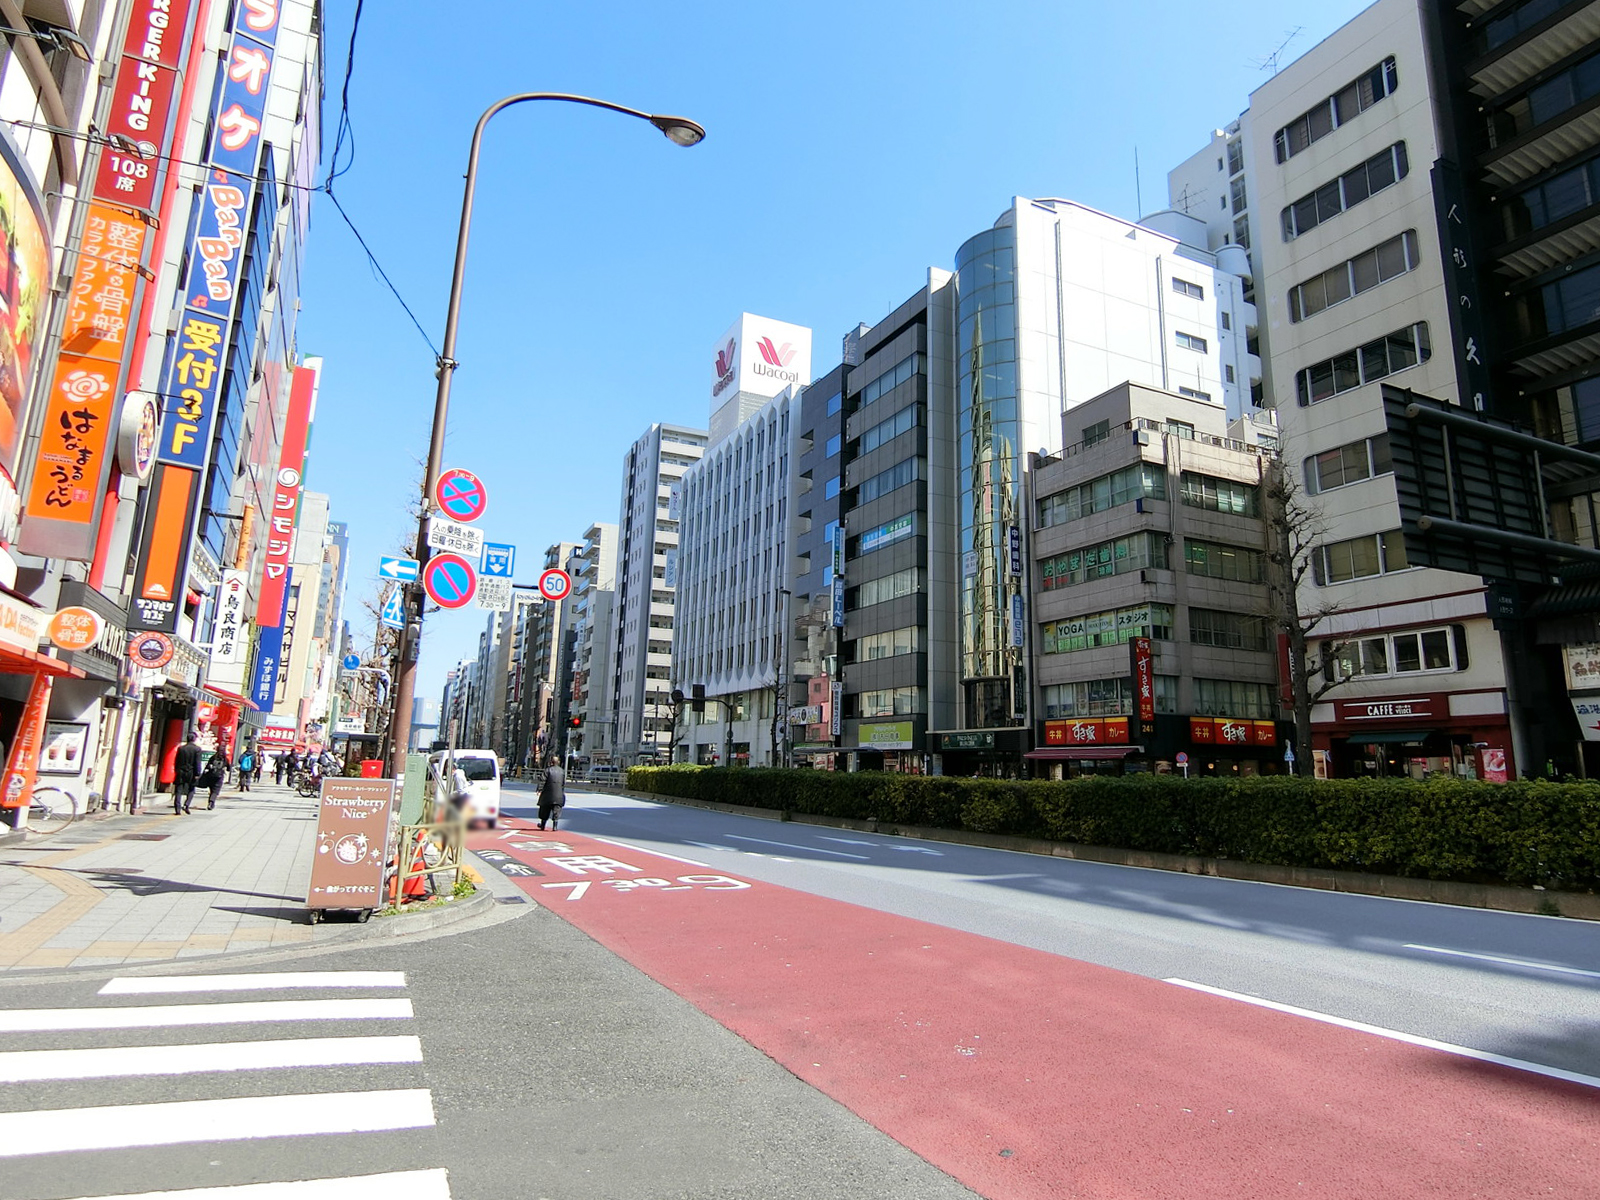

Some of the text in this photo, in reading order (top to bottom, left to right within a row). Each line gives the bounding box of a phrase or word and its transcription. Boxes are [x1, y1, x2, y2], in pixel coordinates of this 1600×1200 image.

[128, 62, 160, 131] KING
[110, 156, 149, 178] 108
[115, 176, 137, 192] 席
[753, 362, 799, 383] Wacoal
[266, 493, 294, 580] シモジマ
[546, 577, 564, 592] 50
[137, 598, 175, 613] サンマルク
[142, 609, 166, 622] カフェ
[1118, 611, 1148, 626] スタジオ
[1058, 623, 1084, 636] YOGA
[258, 656, 274, 701] みずほ銀行
[1138, 656, 1150, 698] すき家
[1049, 729, 1062, 740] 牛丼
[1072, 721, 1096, 743] すき家
[1108, 727, 1125, 738] カレー
[1194, 726, 1209, 738] 牛丼
[1221, 719, 1247, 744] すき家
[1257, 729, 1273, 741] カレー
[325, 794, 387, 810] Strawberry
[341, 808, 368, 819] Nice
[326, 884, 375, 893] 曲がってすぐそこ
